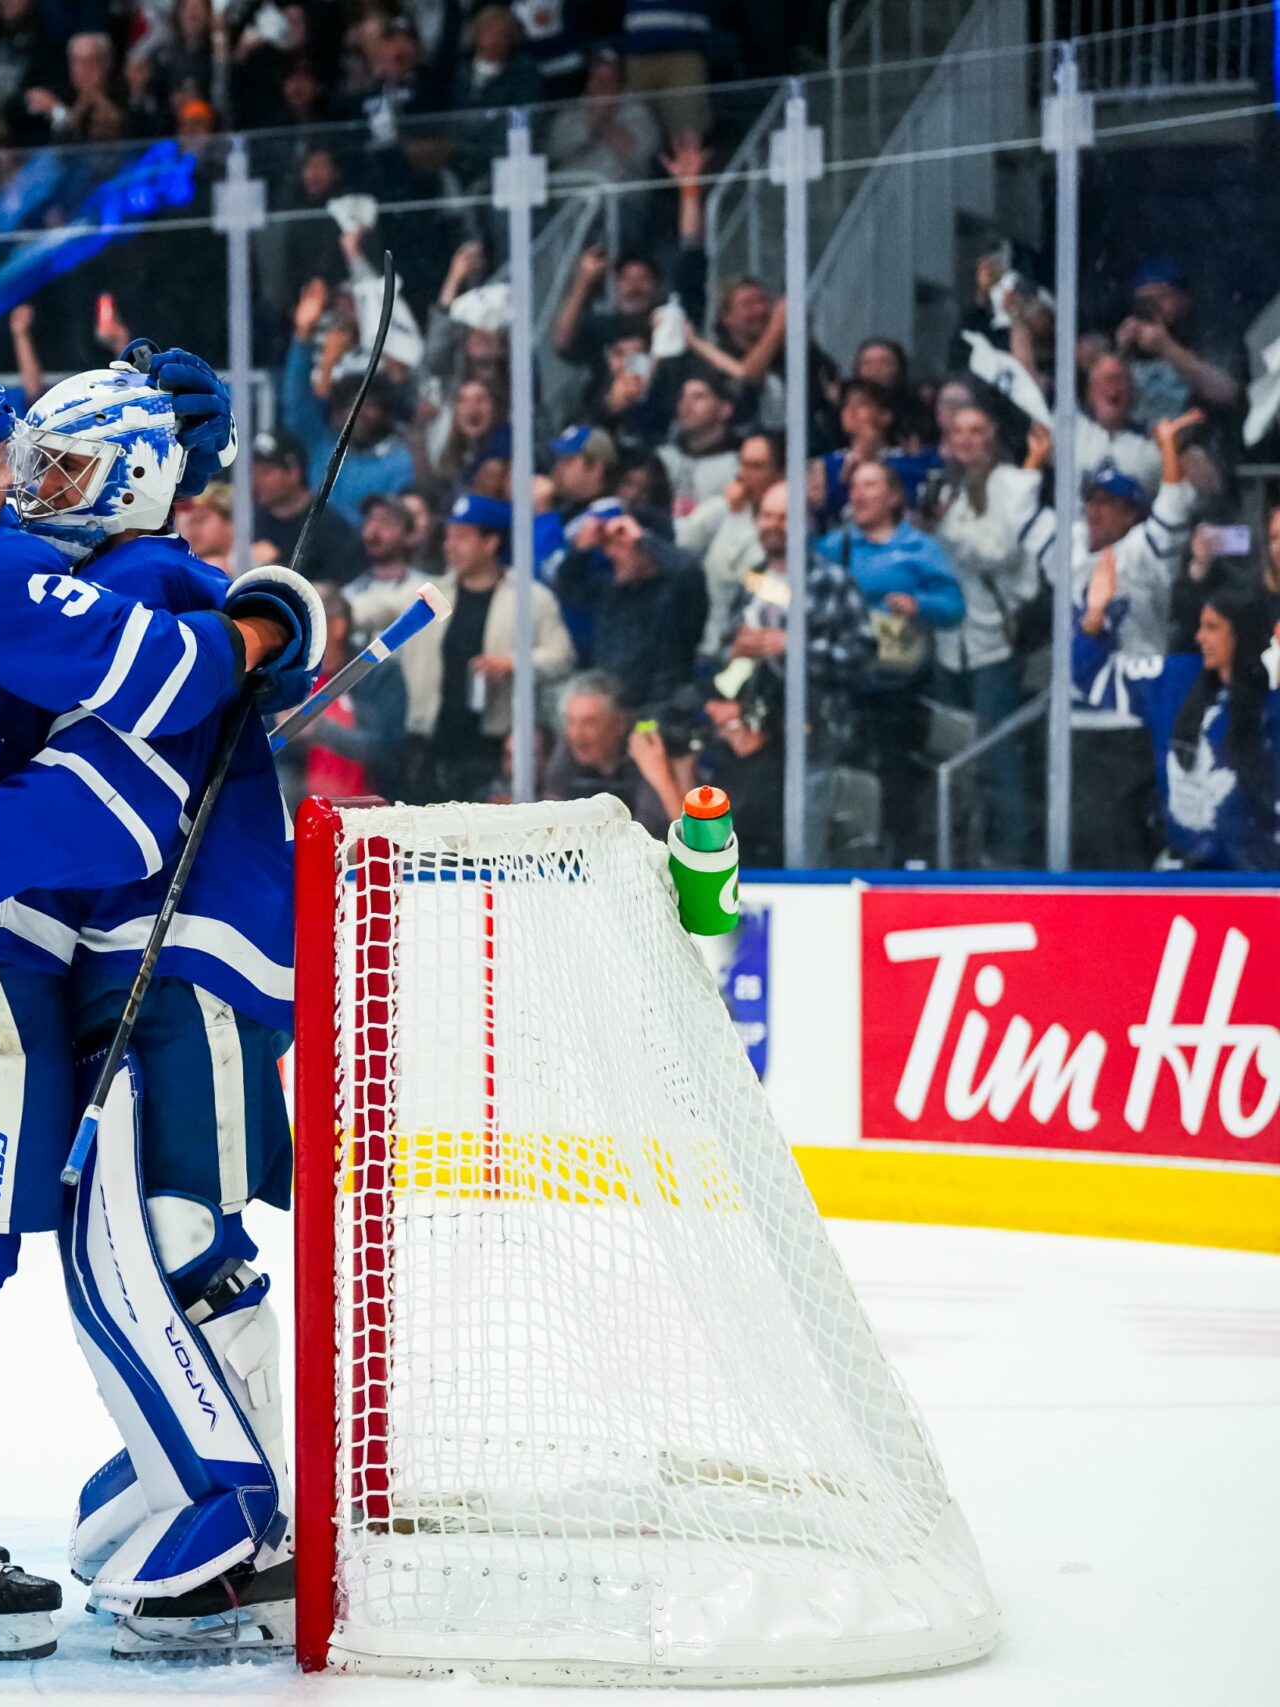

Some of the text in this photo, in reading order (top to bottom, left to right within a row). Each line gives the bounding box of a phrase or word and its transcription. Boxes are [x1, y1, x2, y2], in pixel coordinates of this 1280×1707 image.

[27, 573, 113, 618] 3
[883, 921, 1107, 1131] Tim
[165, 1314, 220, 1432] VAPOR
